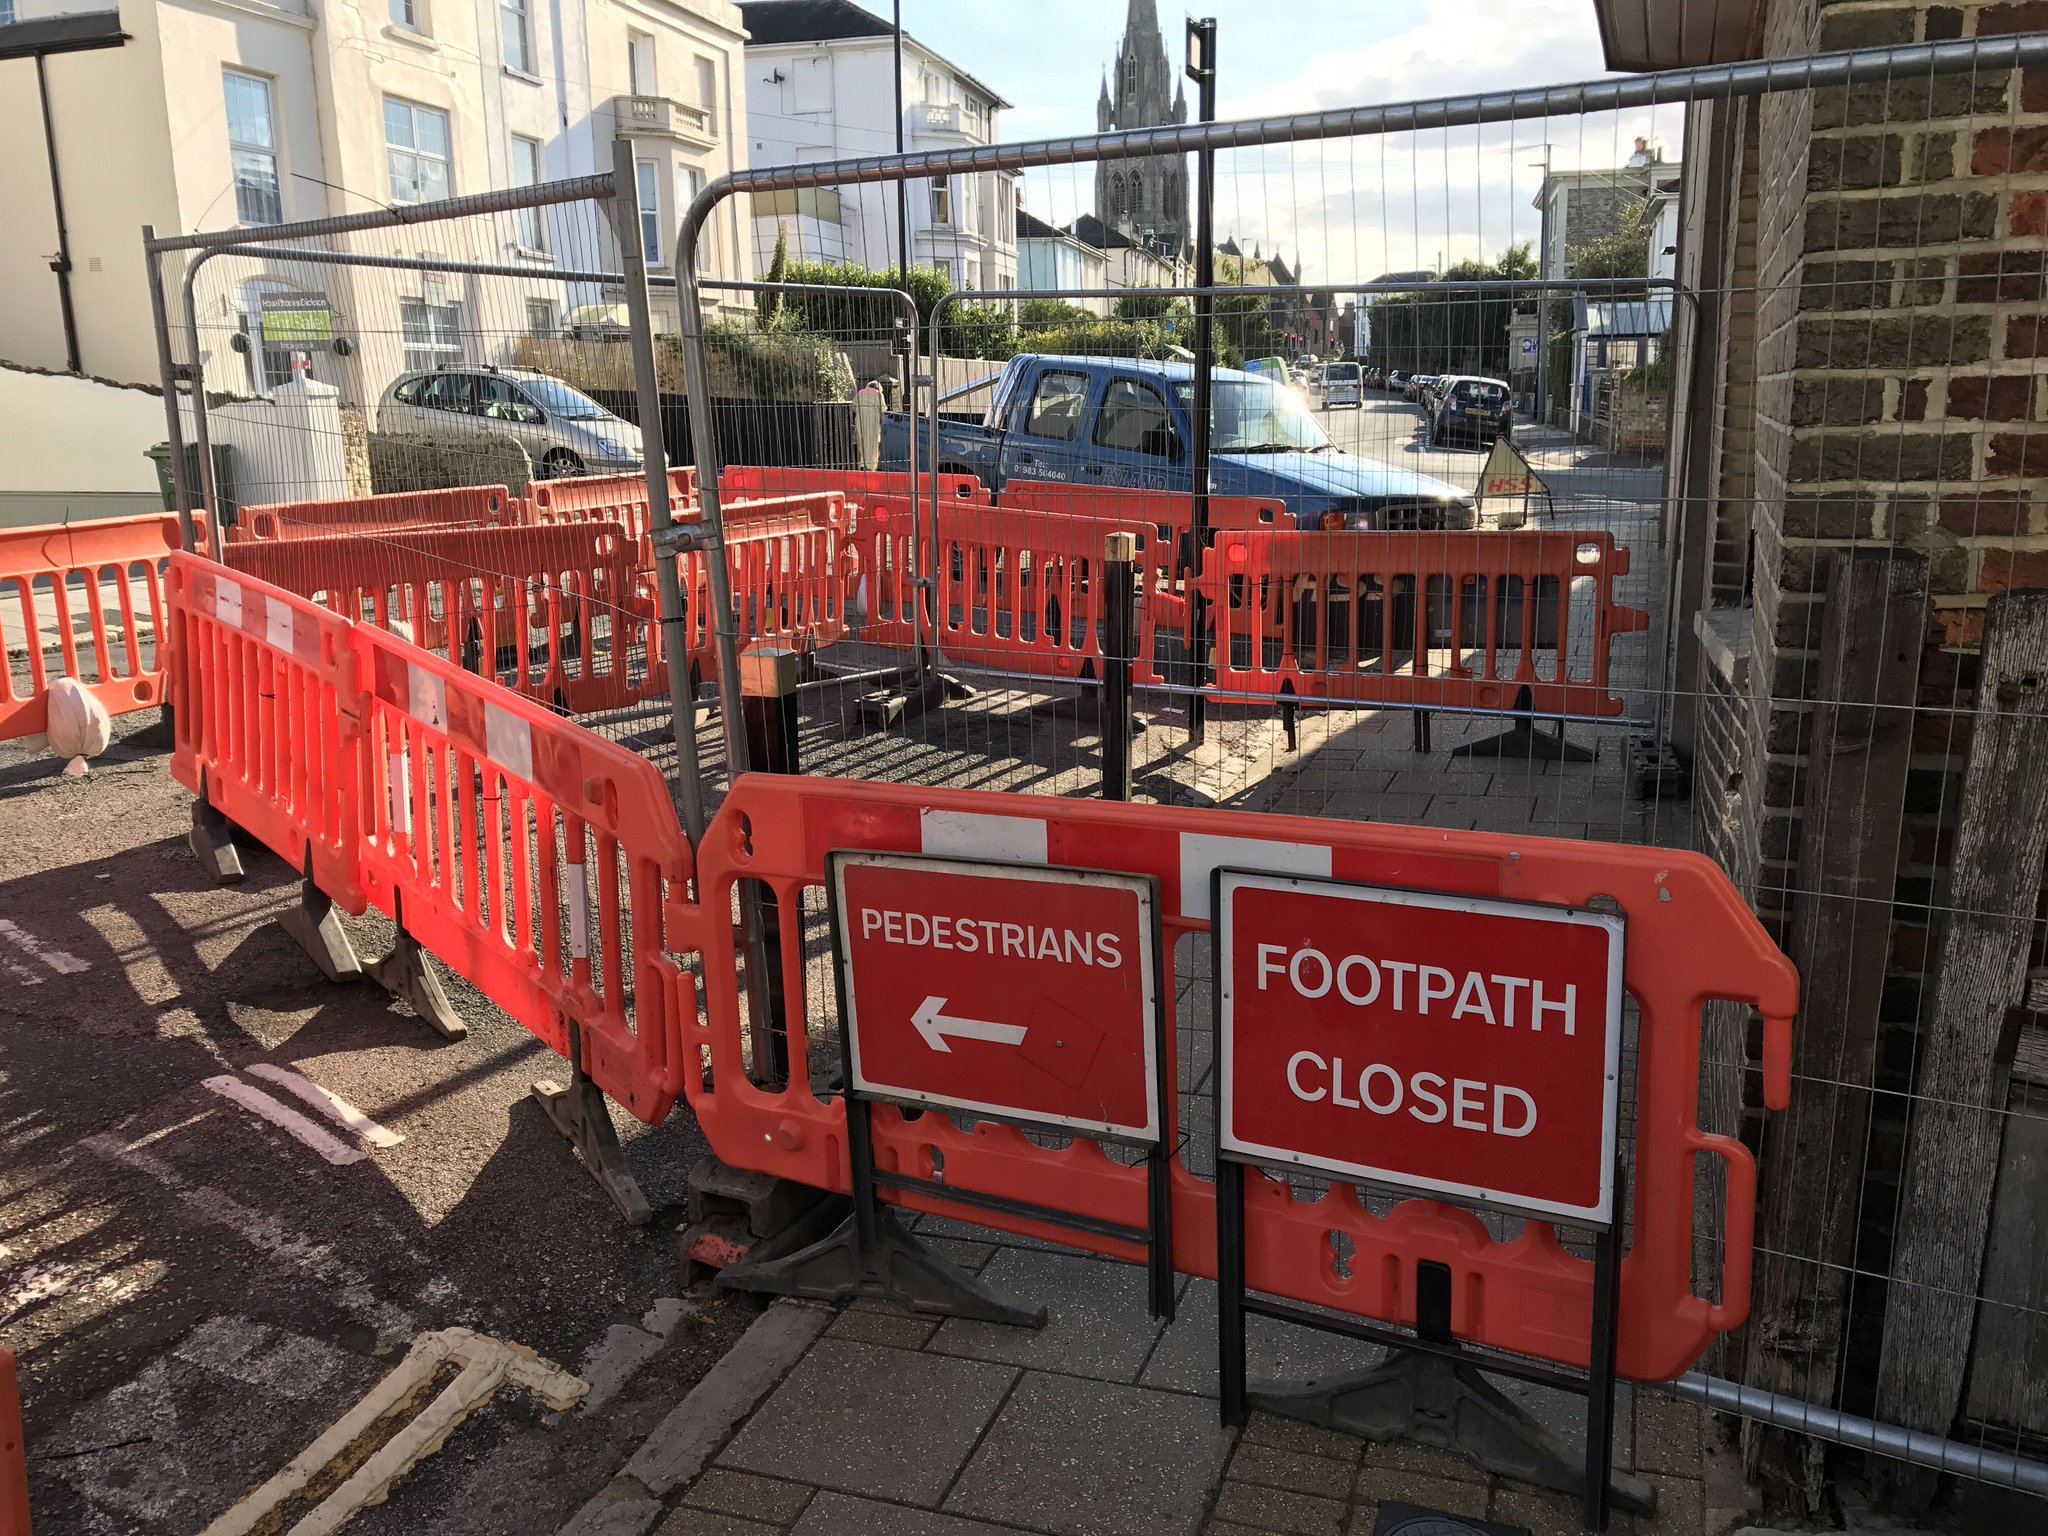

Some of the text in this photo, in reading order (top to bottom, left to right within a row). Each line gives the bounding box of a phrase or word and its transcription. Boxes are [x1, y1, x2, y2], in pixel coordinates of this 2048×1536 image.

[270, 313, 322, 331] For Sale
[1034, 458, 1048, 468] Tel:
[1102, 466, 1167, 490] ISLAND
[1488, 478, 1532, 492] HSS
[861, 908, 1122, 969] PEDESTRIANS
[1257, 943, 1577, 1036] FOOTPATH
[1287, 1051, 1538, 1137] CLOSED
